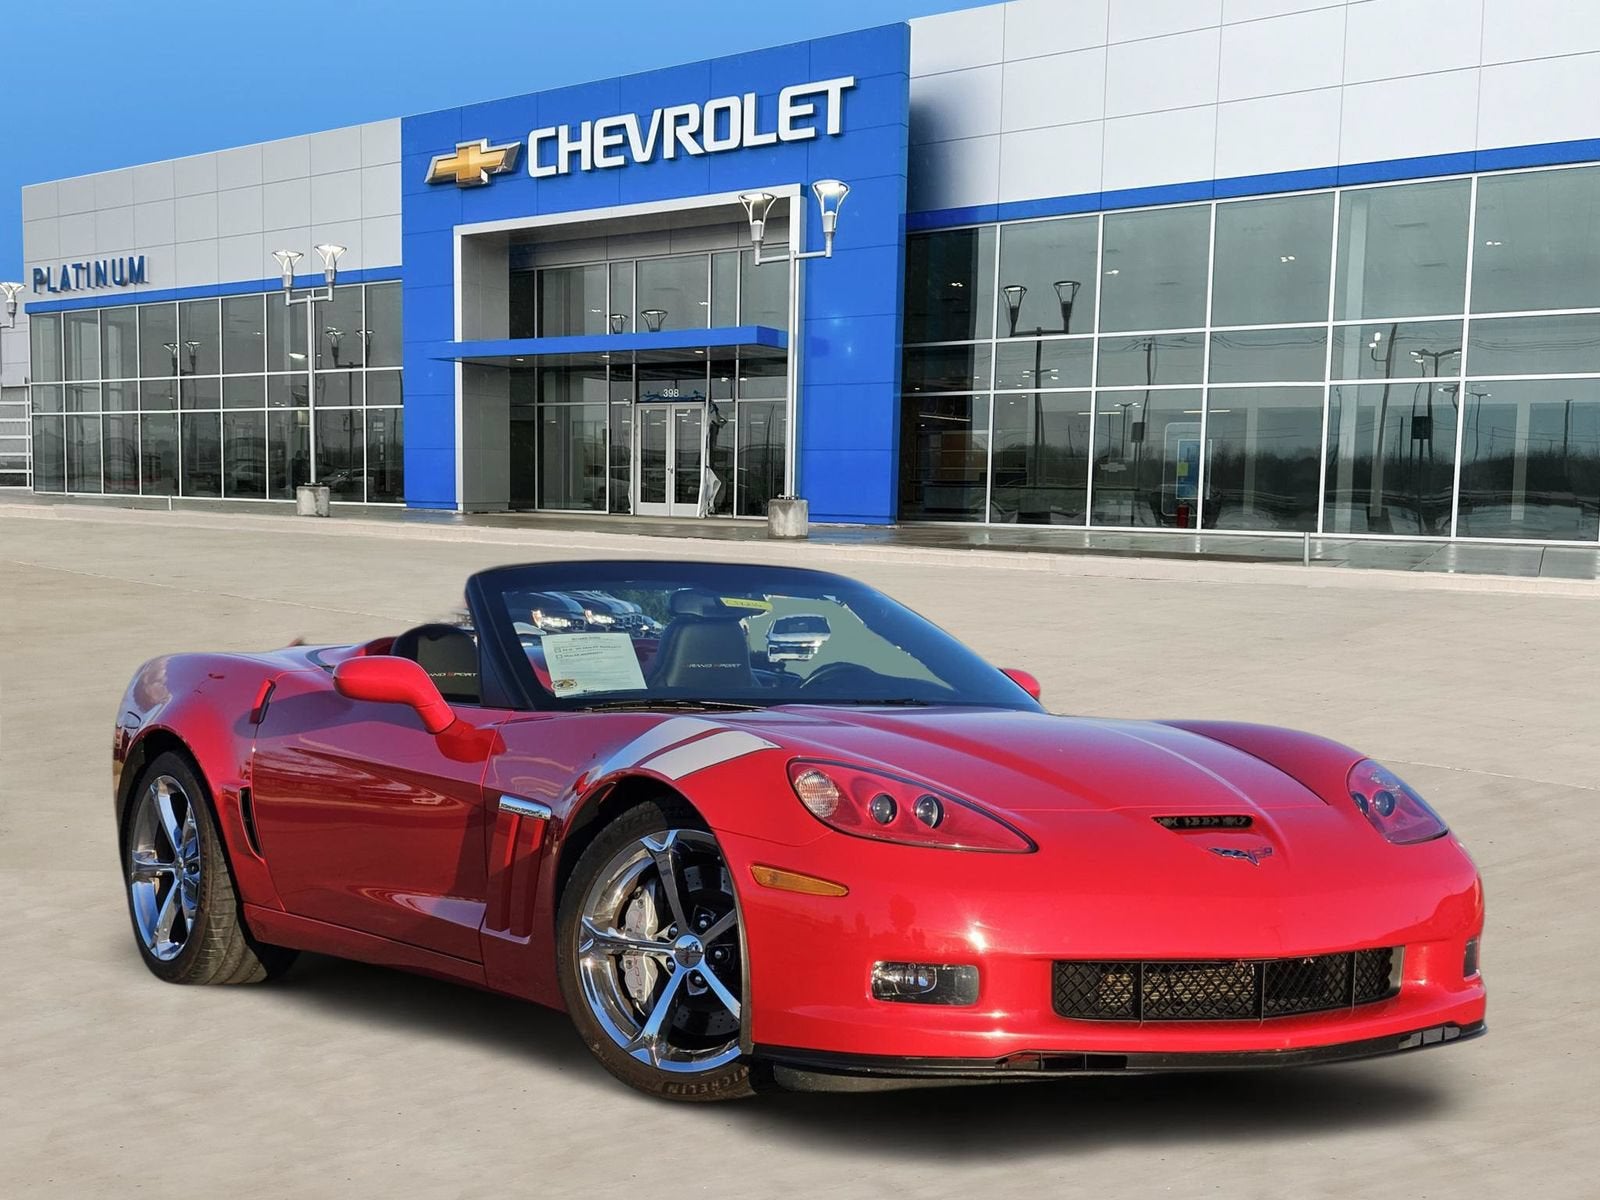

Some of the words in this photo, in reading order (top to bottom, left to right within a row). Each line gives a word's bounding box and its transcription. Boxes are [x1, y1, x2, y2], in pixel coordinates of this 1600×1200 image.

[527, 76, 855, 178] CHEVROLET
[33, 255, 146, 294] PLATINUM
[663, 388, 680, 398] 398
